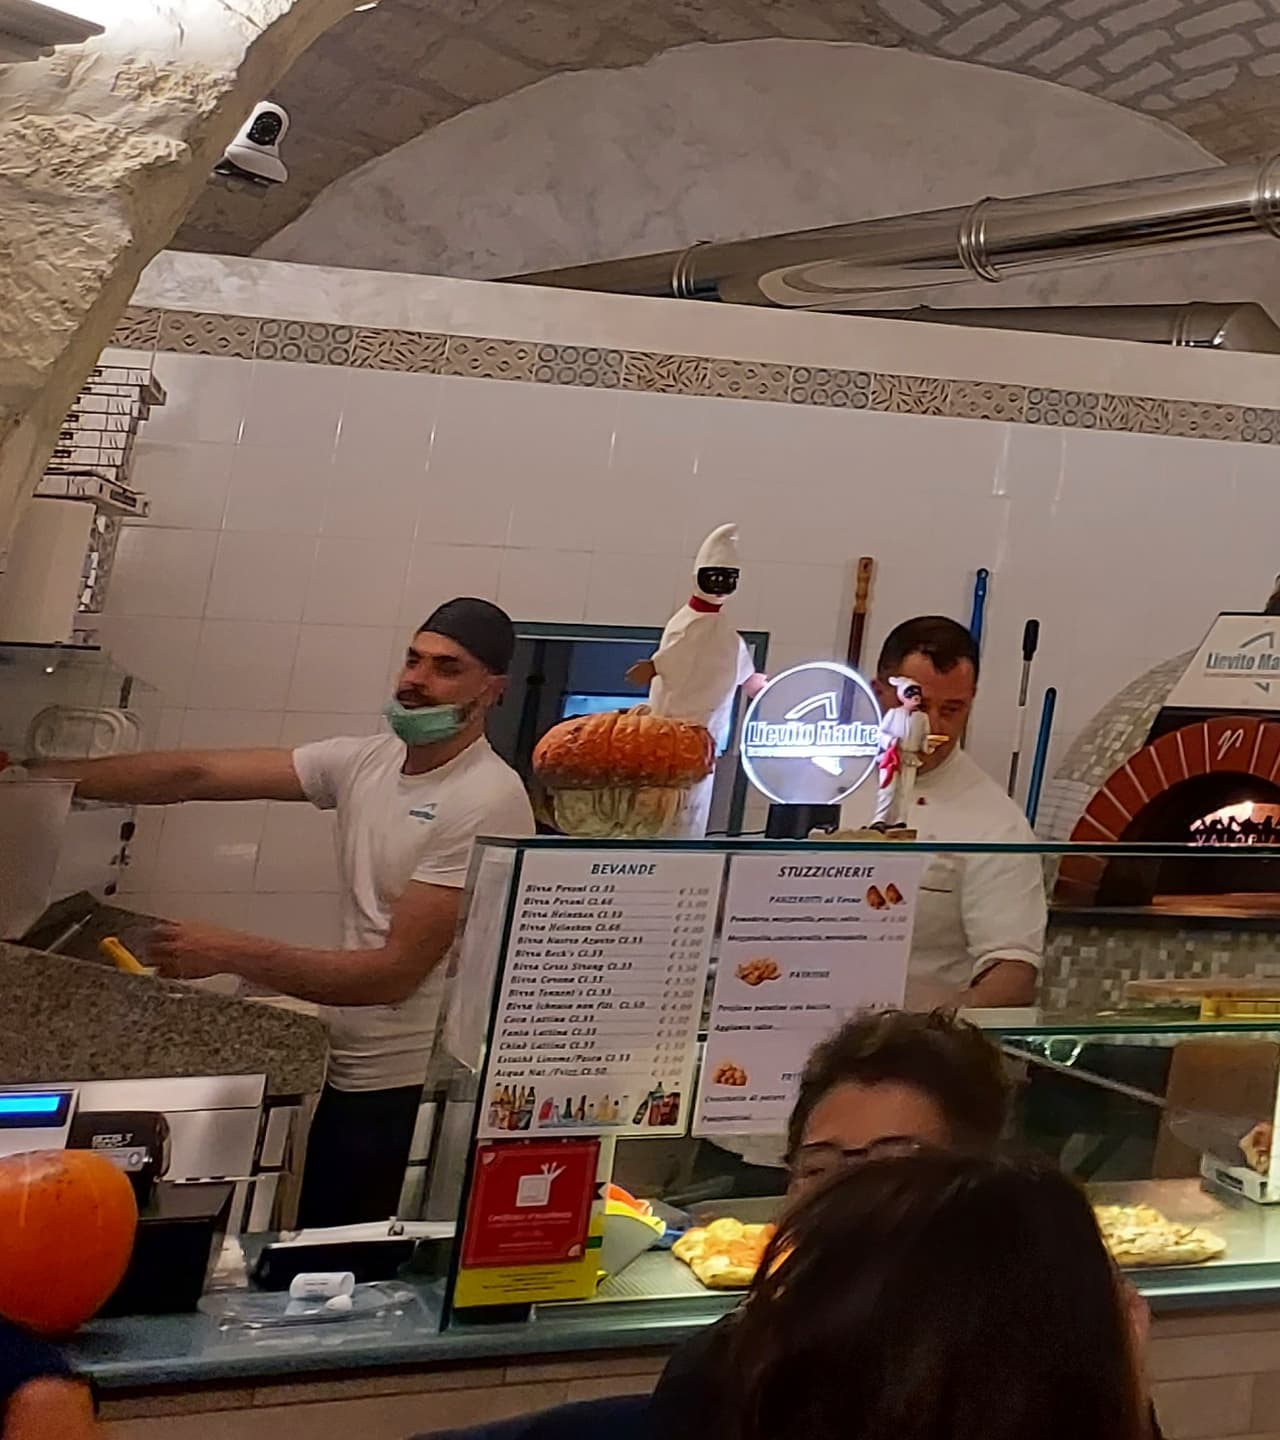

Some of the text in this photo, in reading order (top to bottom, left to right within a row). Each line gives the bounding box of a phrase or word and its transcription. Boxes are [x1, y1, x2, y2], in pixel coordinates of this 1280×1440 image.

[1206, 652, 1256, 670] Lievito
[591, 863, 656, 876] BEVANDE
[778, 866, 875, 879] STUZZICHERIE
